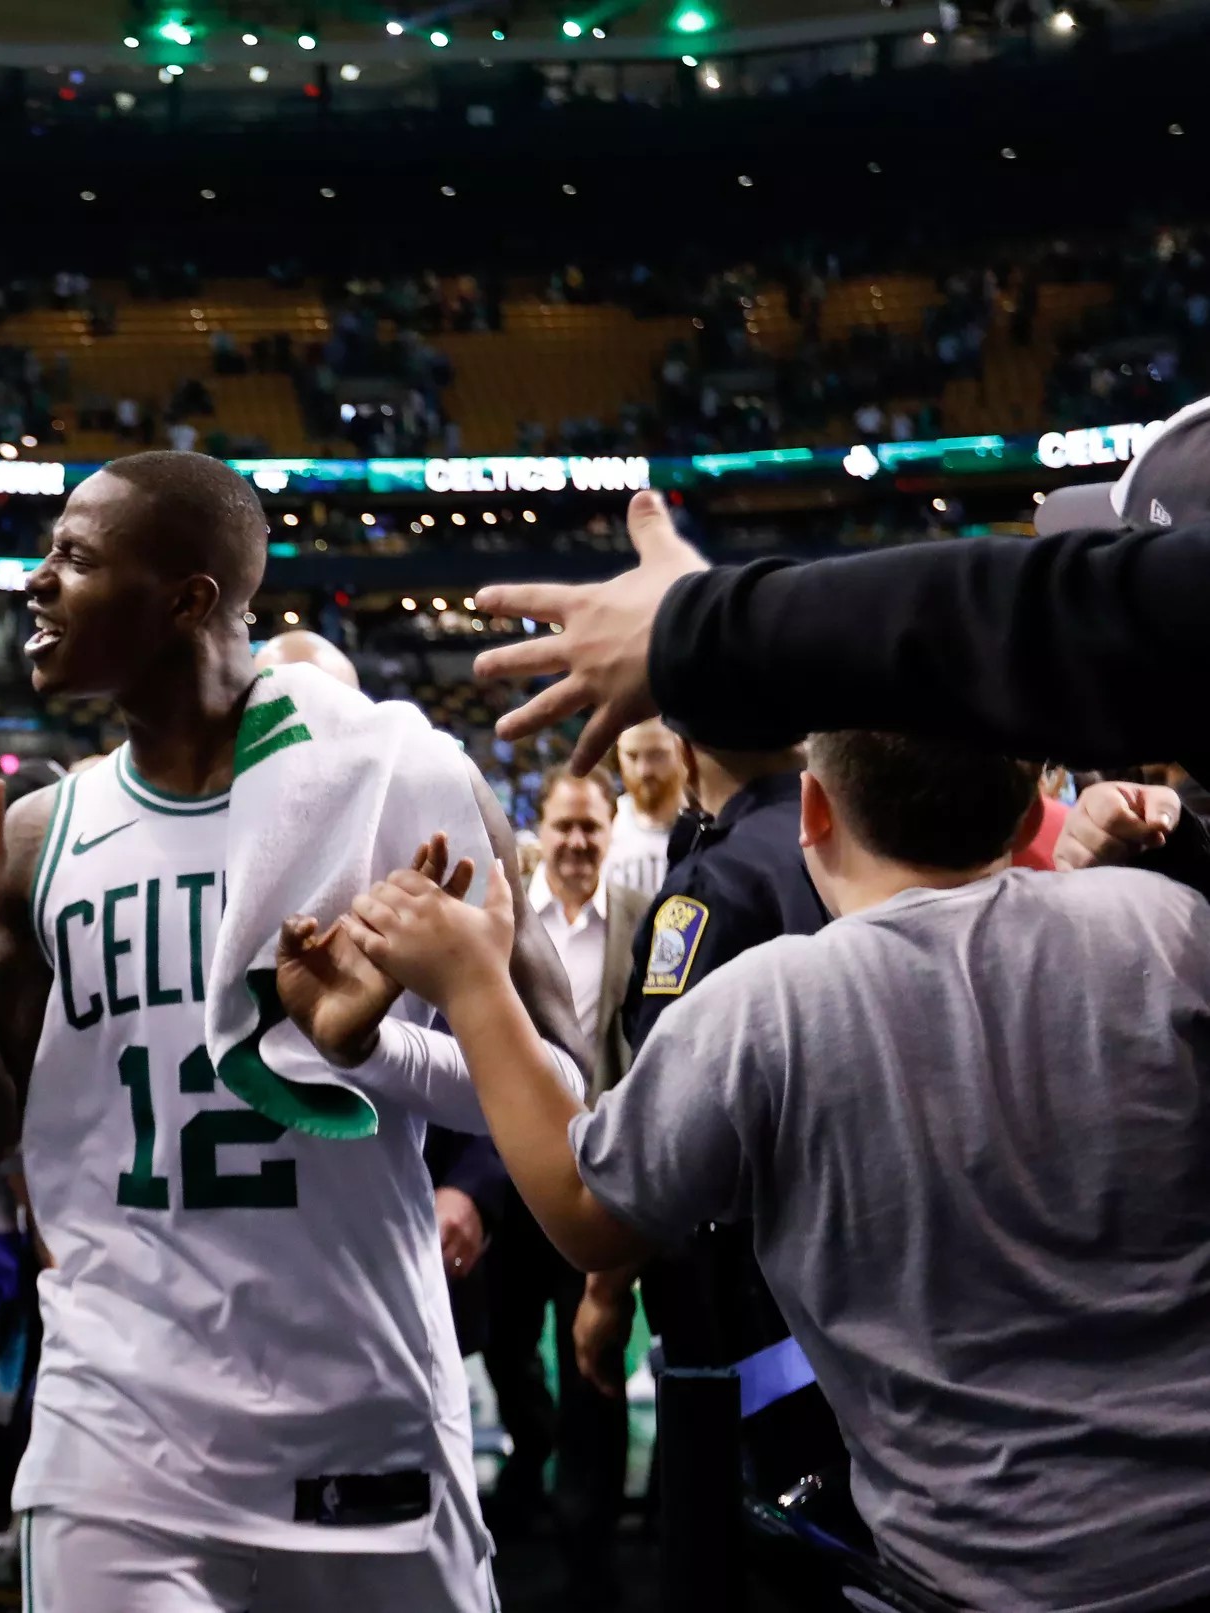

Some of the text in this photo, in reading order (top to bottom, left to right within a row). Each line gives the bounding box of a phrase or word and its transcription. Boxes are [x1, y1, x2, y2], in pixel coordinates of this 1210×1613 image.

[425, 457, 566, 492] CELTICS
[55, 870, 227, 1031] CELT
[116, 1045, 298, 1210] 12
